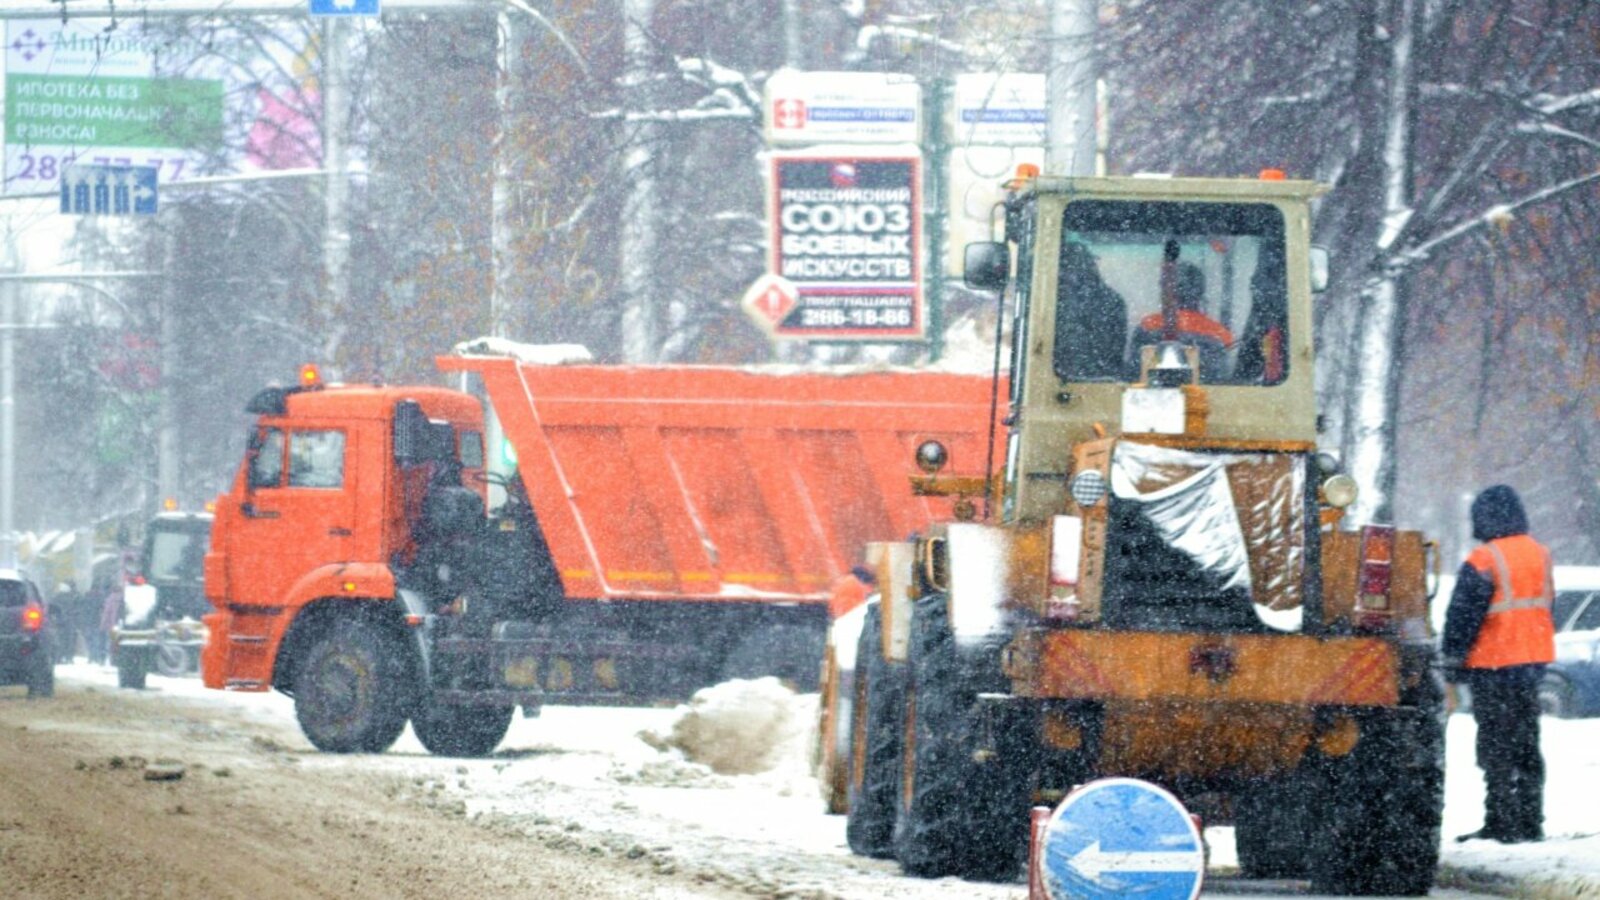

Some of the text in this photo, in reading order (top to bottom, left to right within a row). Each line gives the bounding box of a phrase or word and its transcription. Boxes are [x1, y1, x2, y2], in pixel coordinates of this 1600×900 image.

[17, 82, 139, 100] ИПОТЕКА БЕЗ
[17, 123, 97, 141] ВЗНОСА!
[781, 186, 911, 202] РОССИЙСКИЙ
[782, 203, 911, 232] СОЮЗ
[782, 235, 911, 255] БОЕВЫХ
[782, 257, 911, 277] ИСКУССТВ
